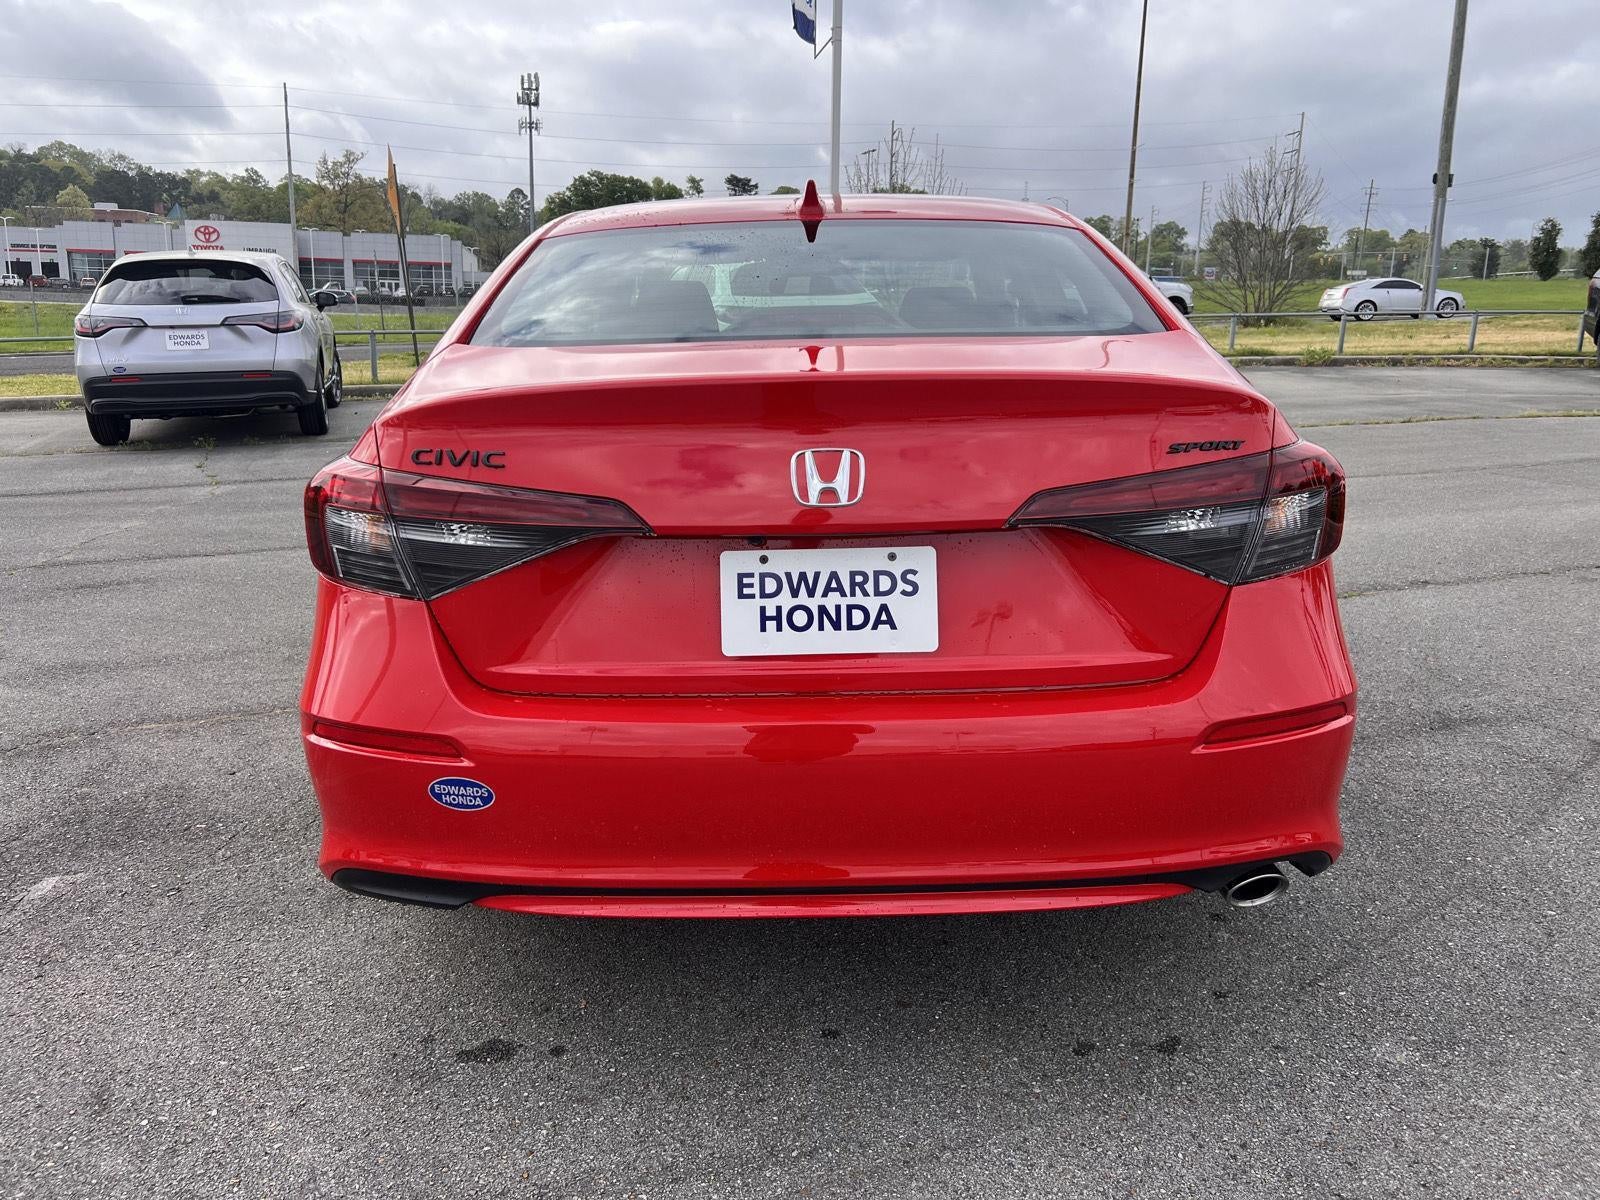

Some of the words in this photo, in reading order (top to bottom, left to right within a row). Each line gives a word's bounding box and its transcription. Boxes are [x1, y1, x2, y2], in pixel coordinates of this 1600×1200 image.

[168, 333, 206, 341] EDWARDS
[1166, 440, 1246, 455] SPORT
[411, 448, 506, 469] CIVIC
[736, 568, 920, 600] EDWARDS
[759, 603, 898, 633] HONDA
[434, 784, 489, 797] EDWARDS
[441, 794, 484, 806] HONDA
